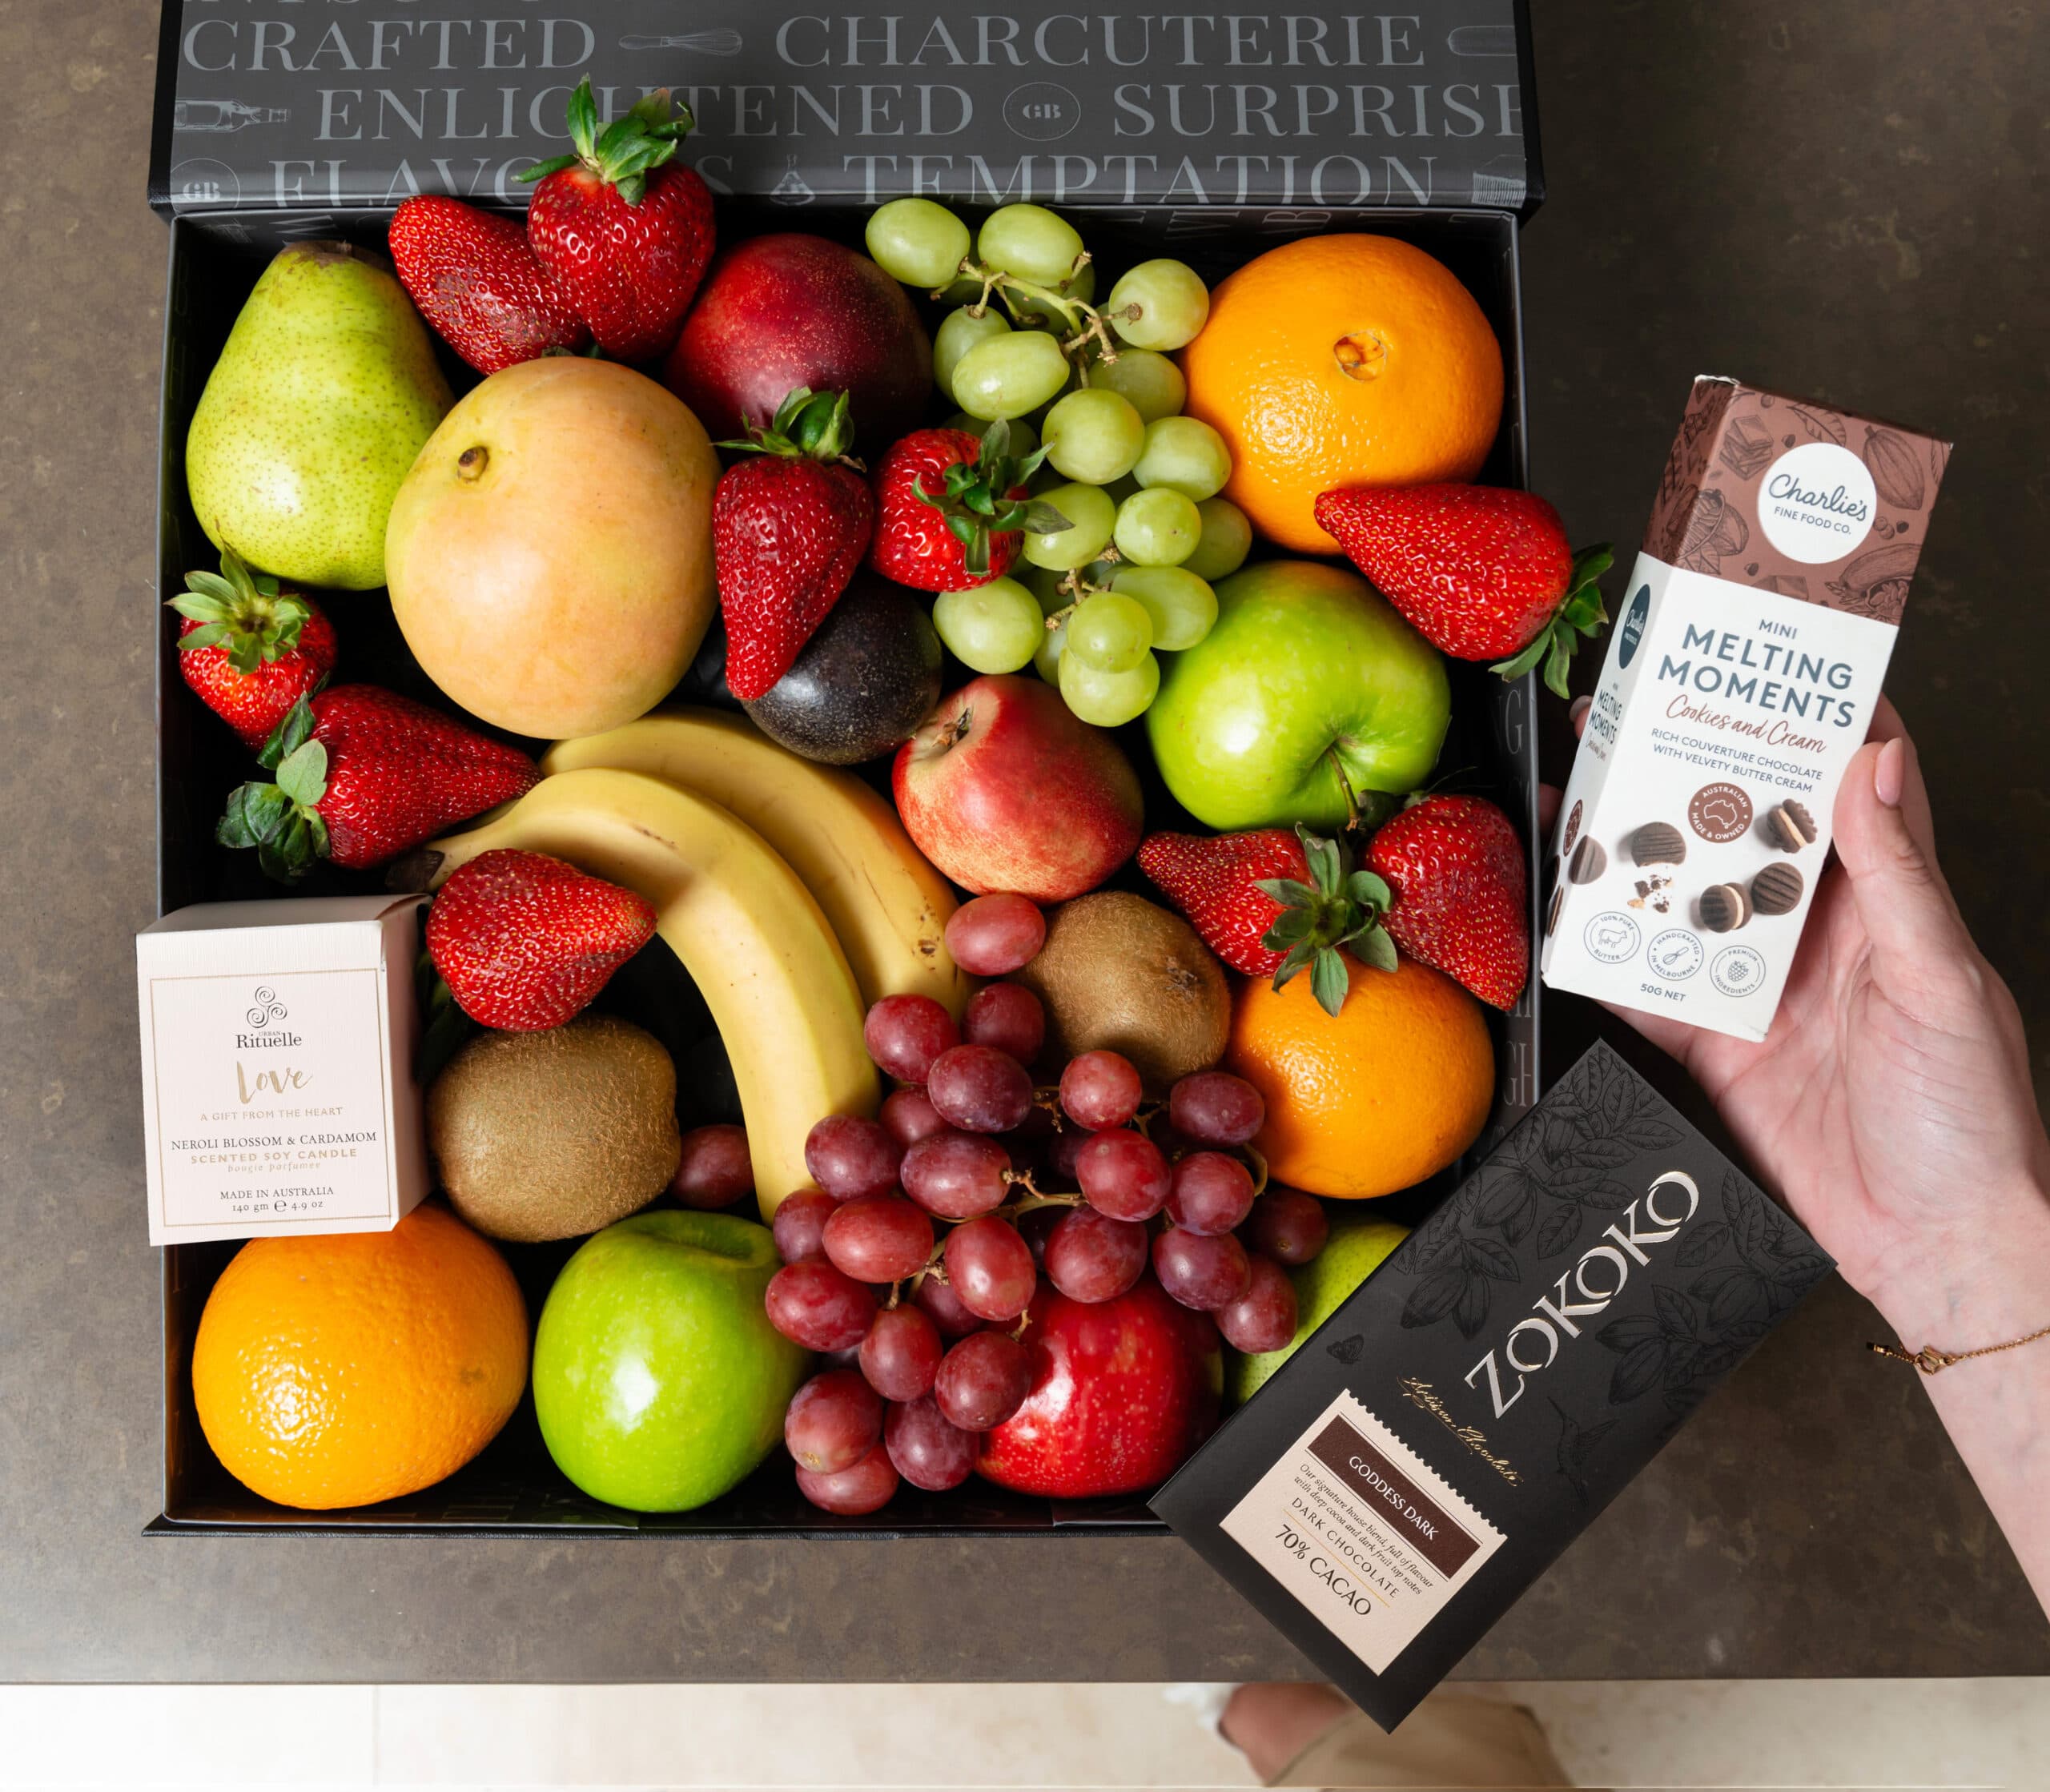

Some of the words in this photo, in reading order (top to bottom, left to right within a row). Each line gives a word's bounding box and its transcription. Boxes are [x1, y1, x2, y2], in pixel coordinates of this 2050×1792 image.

[183, 18, 596, 71] CRAFTED
[776, 14, 1425, 67] CHARCUTERIE
[1114, 83, 1523, 138] SURPRISE
[843, 155, 1437, 207] TEMPTATION
[1768, 473, 1868, 521] Charlie's
[1775, 506, 1799, 520] FINE
[1801, 513, 1831, 528] FOOD
[1834, 523, 1851, 534] CO.
[1759, 620, 1797, 639] MINI
[1682, 624, 1852, 689] MELTING
[1658, 655, 1855, 727] MOMENTS
[1666, 694, 1730, 729] Cookies
[1731, 720, 1767, 738] and
[1765, 721, 1826, 753] Cream
[1651, 729, 1678, 742] RICH
[1682, 737, 1755, 762] COUVERTURE
[1758, 757, 1823, 780] CHOCOLATE
[1654, 744, 1682, 758] WITH
[1686, 753, 1730, 770] VELVETY
[1733, 765, 1773, 783] BUTTER
[1775, 777, 1812, 793] CREAM
[1702, 786, 1748, 808] AUSTRALIAN
[1692, 812, 1706, 834] MADE
[1715, 823, 1745, 840] OWNED
[1657, 933, 1699, 955] HANDCRAFTED
[1641, 983, 1662, 995] 50G
[1665, 990, 1686, 1001] NET
[235, 1032, 303, 1049] Rituelle
[212, 1112, 237, 1120] GIFT
[243, 1110, 274, 1119] FROM
[279, 1109, 300, 1118] THE
[306, 1107, 343, 1116] HEART
[171, 1139, 219, 1151] NEROLI
[223, 1135, 283, 1148] BLOSSOM
[287, 1136, 295, 1146] &
[300, 1131, 376, 1145] CARDAMOM
[191, 1153, 256, 1164] SCENTED
[264, 1151, 290, 1161] SOY
[298, 1149, 356, 1159] CANDLE
[221, 1191, 252, 1199] MADE
[256, 1190, 268, 1198] IN
[273, 1187, 333, 1197] AUSTRALIA
[232, 1204, 250, 1214] 140
[254, 1204, 269, 1212] gm
[1465, 1171, 1699, 1420] ZOKOKO
[1300, 1465, 1316, 1479] Our
[1314, 1477, 1348, 1509] signature
[1349, 1457, 1405, 1509] GODDESS
[1400, 1506, 1438, 1540] DARK
[1346, 1507, 1367, 1527] house
[1292, 1497, 1325, 1529] DARK
[1327, 1531, 1399, 1597] CHOCOLATE
[1294, 1477, 1311, 1493] with
[1310, 1493, 1327, 1507] deep
[1326, 1507, 1345, 1525] cocoa
[1345, 1525, 1361, 1537] and
[1359, 1537, 1376, 1552] dark
[1371, 1550, 1392, 1566] fruit
[1391, 1566, 1403, 1577] top
[1403, 1577, 1421, 1594] notes
[1366, 1525, 1388, 1547] blend,
[1384, 1545, 1403, 1559] full
[1400, 1557, 1412, 1567] of
[1276, 1525, 1310, 1559] 70%
[1310, 1557, 1371, 1614] CACAO
[1405, 1564, 1434, 1588] flavour
